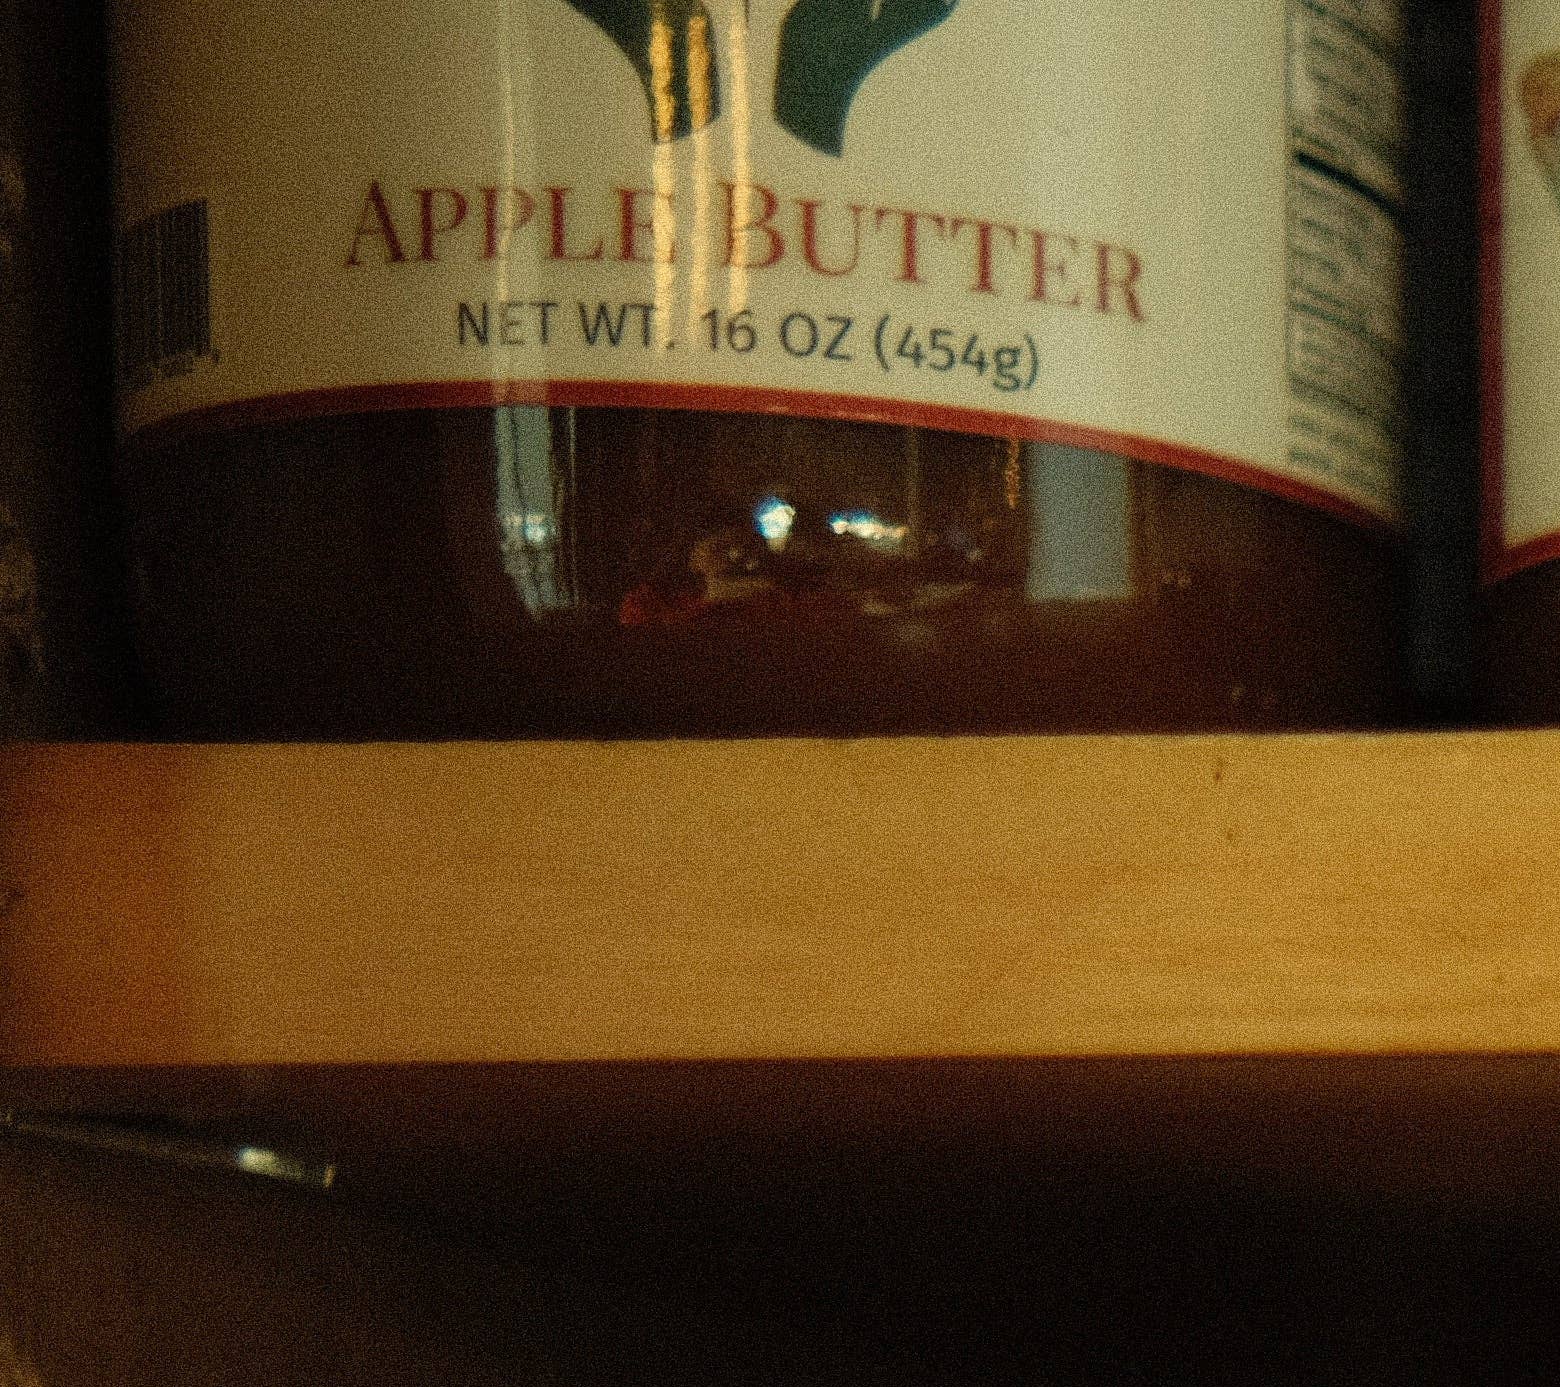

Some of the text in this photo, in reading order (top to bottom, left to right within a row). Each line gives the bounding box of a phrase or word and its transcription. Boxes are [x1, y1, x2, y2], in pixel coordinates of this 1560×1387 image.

[344, 178, 1151, 324] APPLE BUTTER
[455, 300, 1043, 392] NET WT. 16 OZ (454g)
